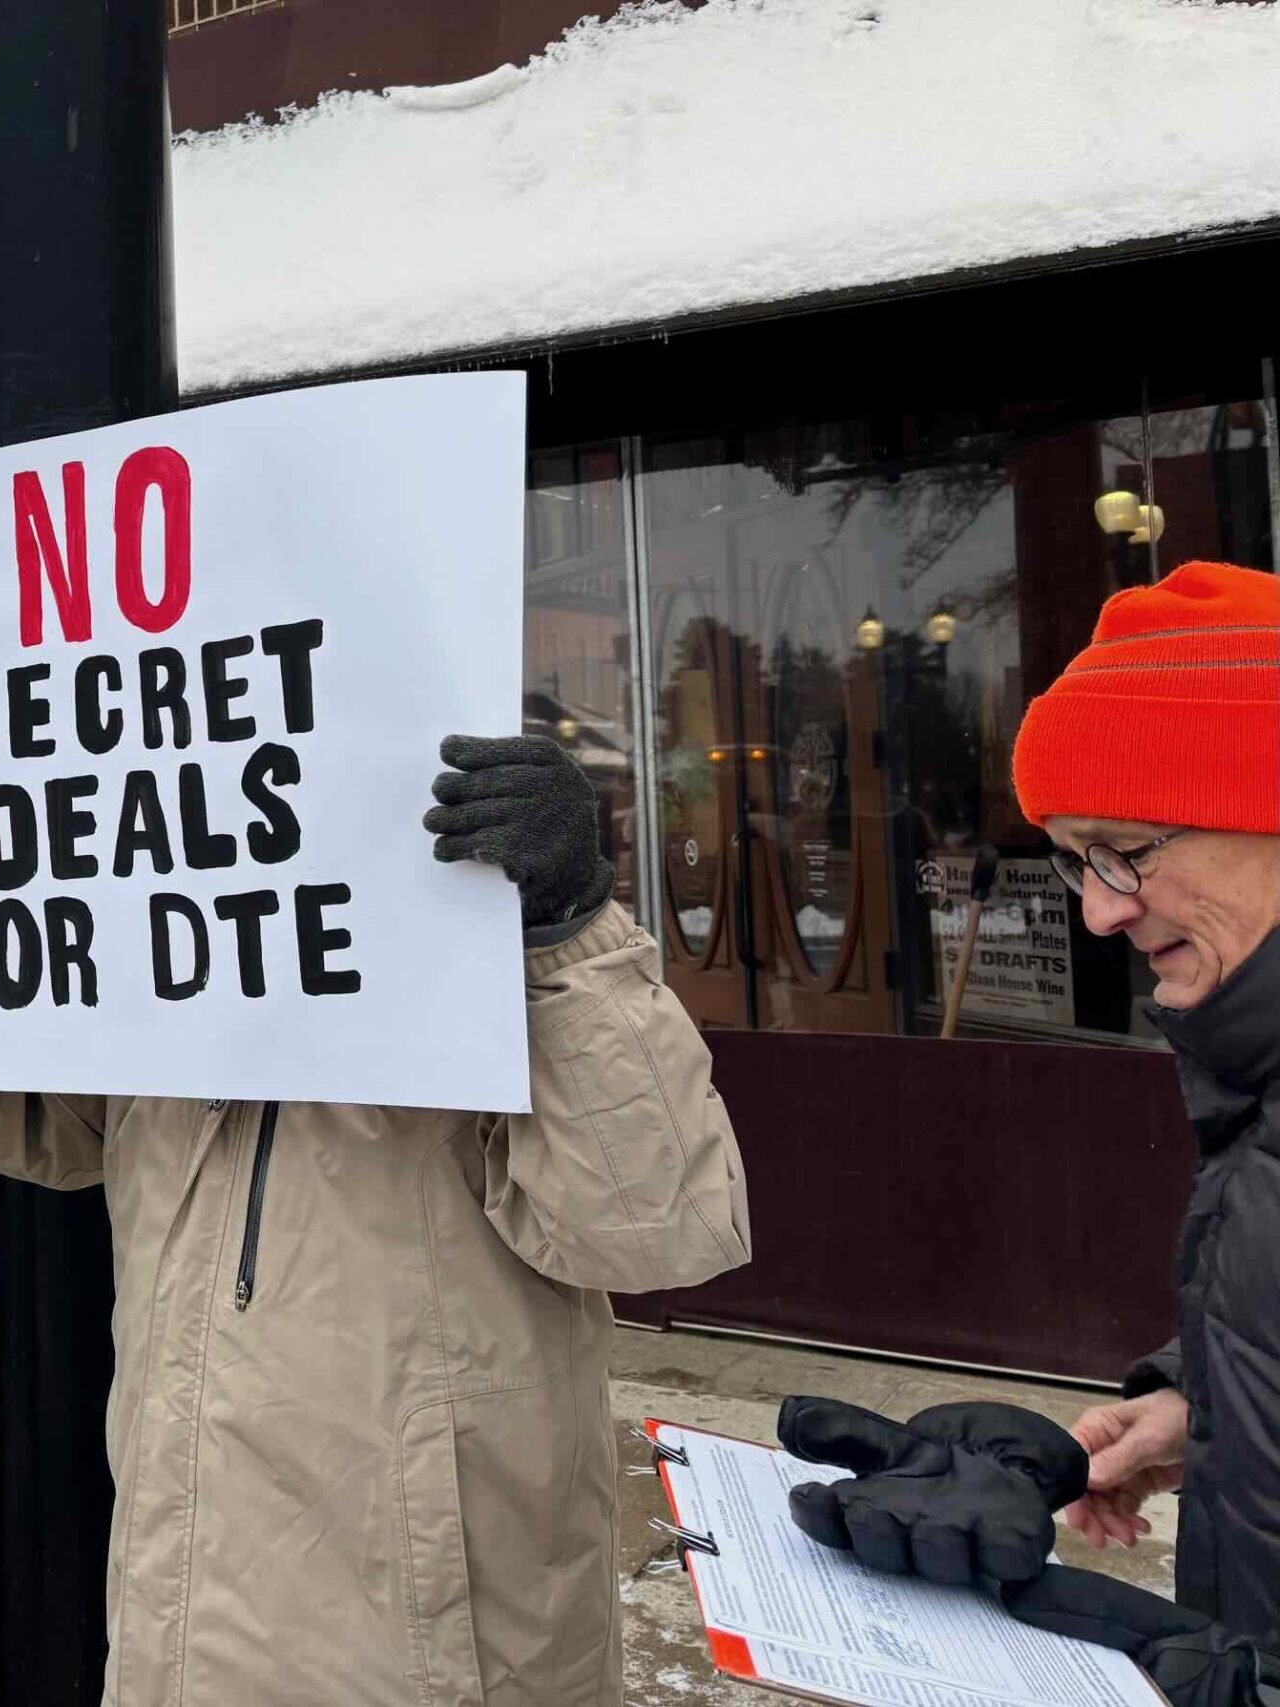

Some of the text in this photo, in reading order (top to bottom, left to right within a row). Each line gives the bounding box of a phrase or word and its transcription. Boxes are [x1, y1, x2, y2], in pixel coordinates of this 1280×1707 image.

[13, 445, 192, 647] NO
[1006, 868, 1052, 885] Hour
[149, 882, 361, 1001] DTE
[1032, 931, 1067, 950] Plates
[981, 951, 1067, 973] DRAFTS
[998, 974, 1034, 992] House
[1036, 979, 1065, 996] Wine
